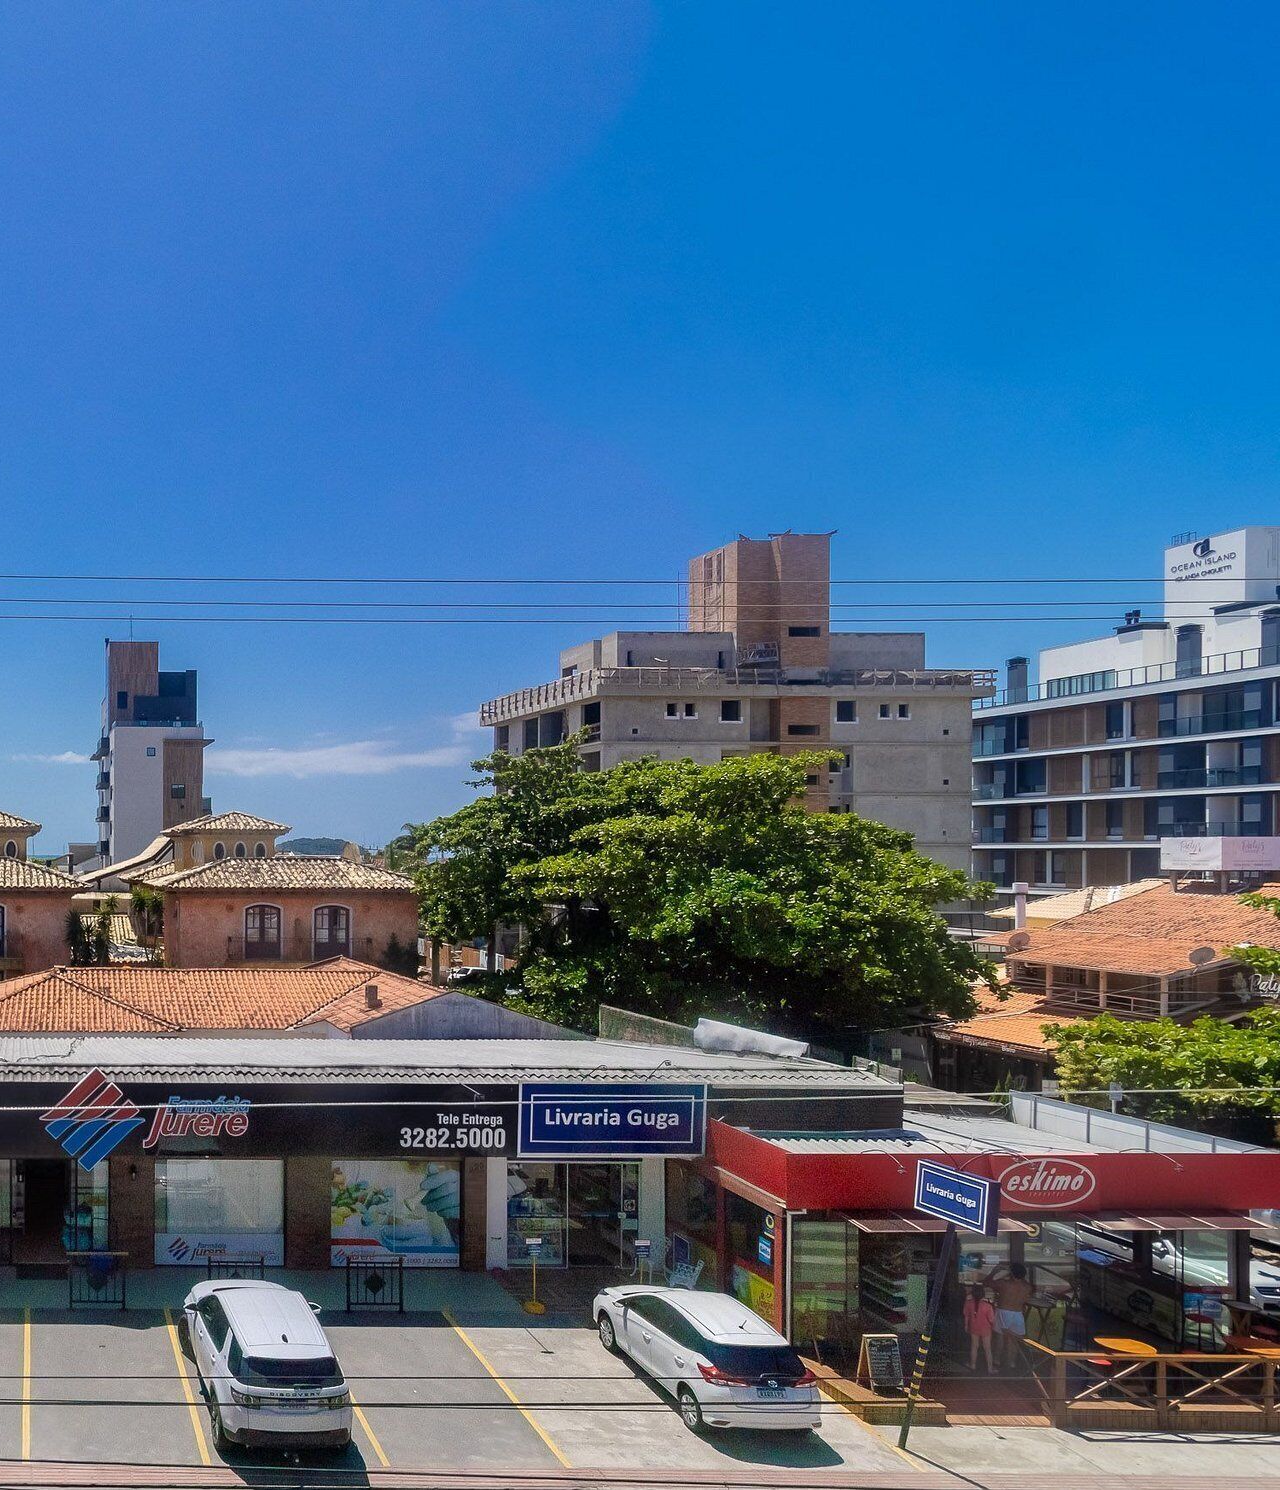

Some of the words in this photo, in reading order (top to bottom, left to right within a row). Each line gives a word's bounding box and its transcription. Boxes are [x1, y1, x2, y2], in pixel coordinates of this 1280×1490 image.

[1170, 560, 1202, 573] OCEAN
[1204, 552, 1237, 565] ISLAND
[166, 1095, 252, 1113] Farmácia
[436, 1113, 460, 1125] Tele
[462, 1113, 503, 1128] Entrega
[545, 1108, 621, 1126] Livraria
[627, 1109, 680, 1130] Guga
[400, 1127, 506, 1149] 3282.5000
[926, 1182, 955, 1200] Livraria
[955, 1193, 977, 1209] Guga
